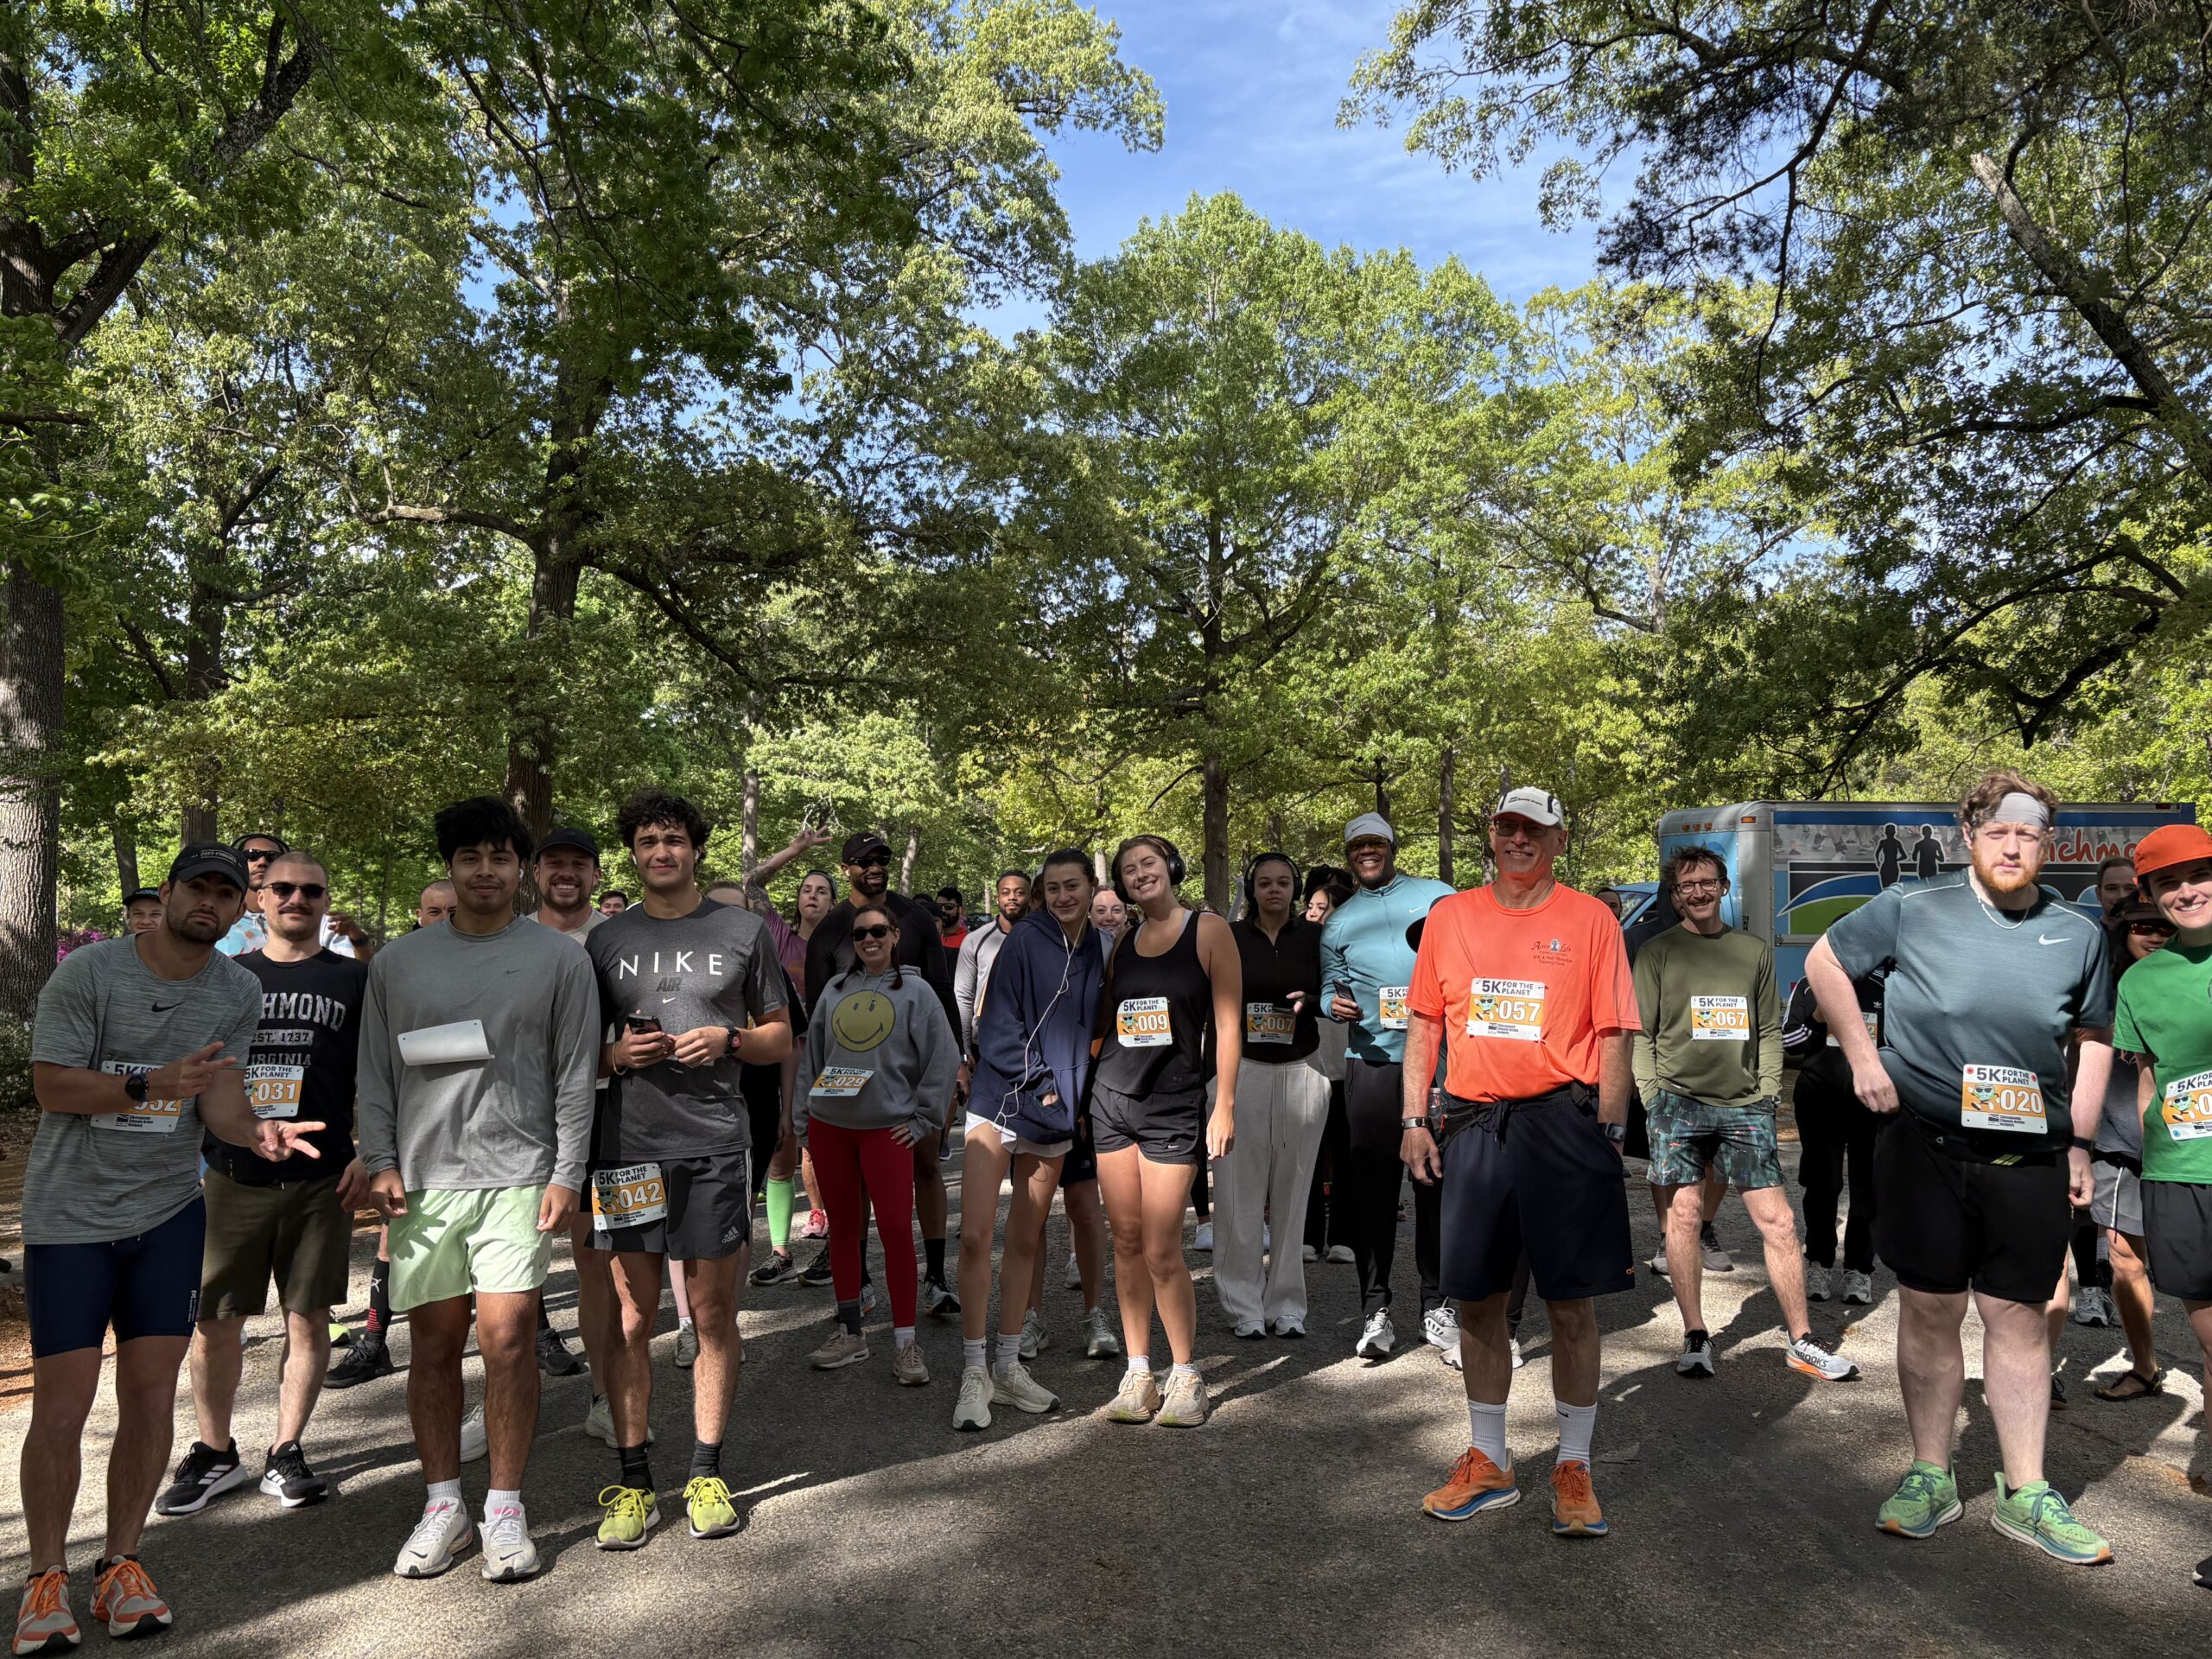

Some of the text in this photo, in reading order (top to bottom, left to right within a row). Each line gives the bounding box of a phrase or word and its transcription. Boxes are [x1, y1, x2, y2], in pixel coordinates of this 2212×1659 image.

[619, 951, 723, 980] NIKE
[656, 977, 683, 992] AIR
[1482, 980, 1502, 994] 5K
[1387, 988, 1402, 998] 5K
[1502, 988, 1530, 996] PLANET
[1123, 1001, 1136, 1012] 5K
[1254, 1004, 1268, 1013] 5K
[1699, 997, 1715, 1007] 5K
[261, 992, 346, 1032] HMOND
[1498, 1000, 1541, 1022] 057
[1138, 1014, 1168, 1032] 009
[1267, 1016, 1294, 1032] 007
[1716, 1010, 1745, 1027] 067
[281, 1032, 308, 1042] 1737
[245, 1066, 260, 1079] 5K
[1976, 1067, 2001, 1083] 5K
[2002, 1069, 2030, 1080] FOR THE
[836, 1077, 865, 1086] 029
[2002, 1076, 2030, 1085] PLANET
[2177, 1076, 2196, 1093] 5K
[257, 1082, 296, 1102] 031
[2000, 1089, 2043, 1114] 020
[599, 1171, 616, 1185] 5K
[614, 1166, 648, 1178] FOR THE
[616, 1173, 646, 1184] PLANET
[619, 1182, 663, 1209] 042
[1795, 1350, 1829, 1368] BROOKS
